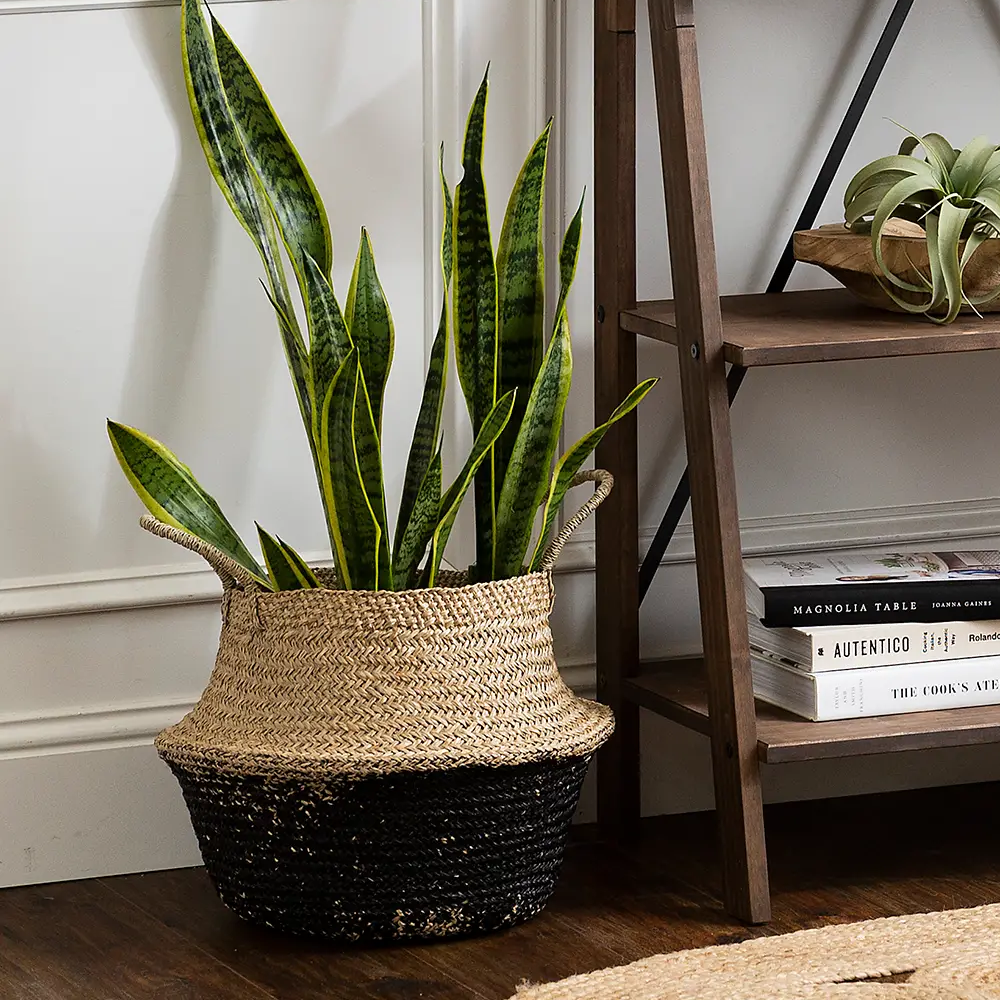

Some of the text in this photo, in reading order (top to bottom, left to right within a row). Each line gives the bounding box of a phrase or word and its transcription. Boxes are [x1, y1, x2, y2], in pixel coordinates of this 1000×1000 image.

[793, 600, 992, 615] MAGNOLIA TABLE JOANNA GAINES
[834, 636, 910, 659] AUTENTICO
[891, 686, 918, 699] THE
[923, 681, 969, 697] COOK'S
